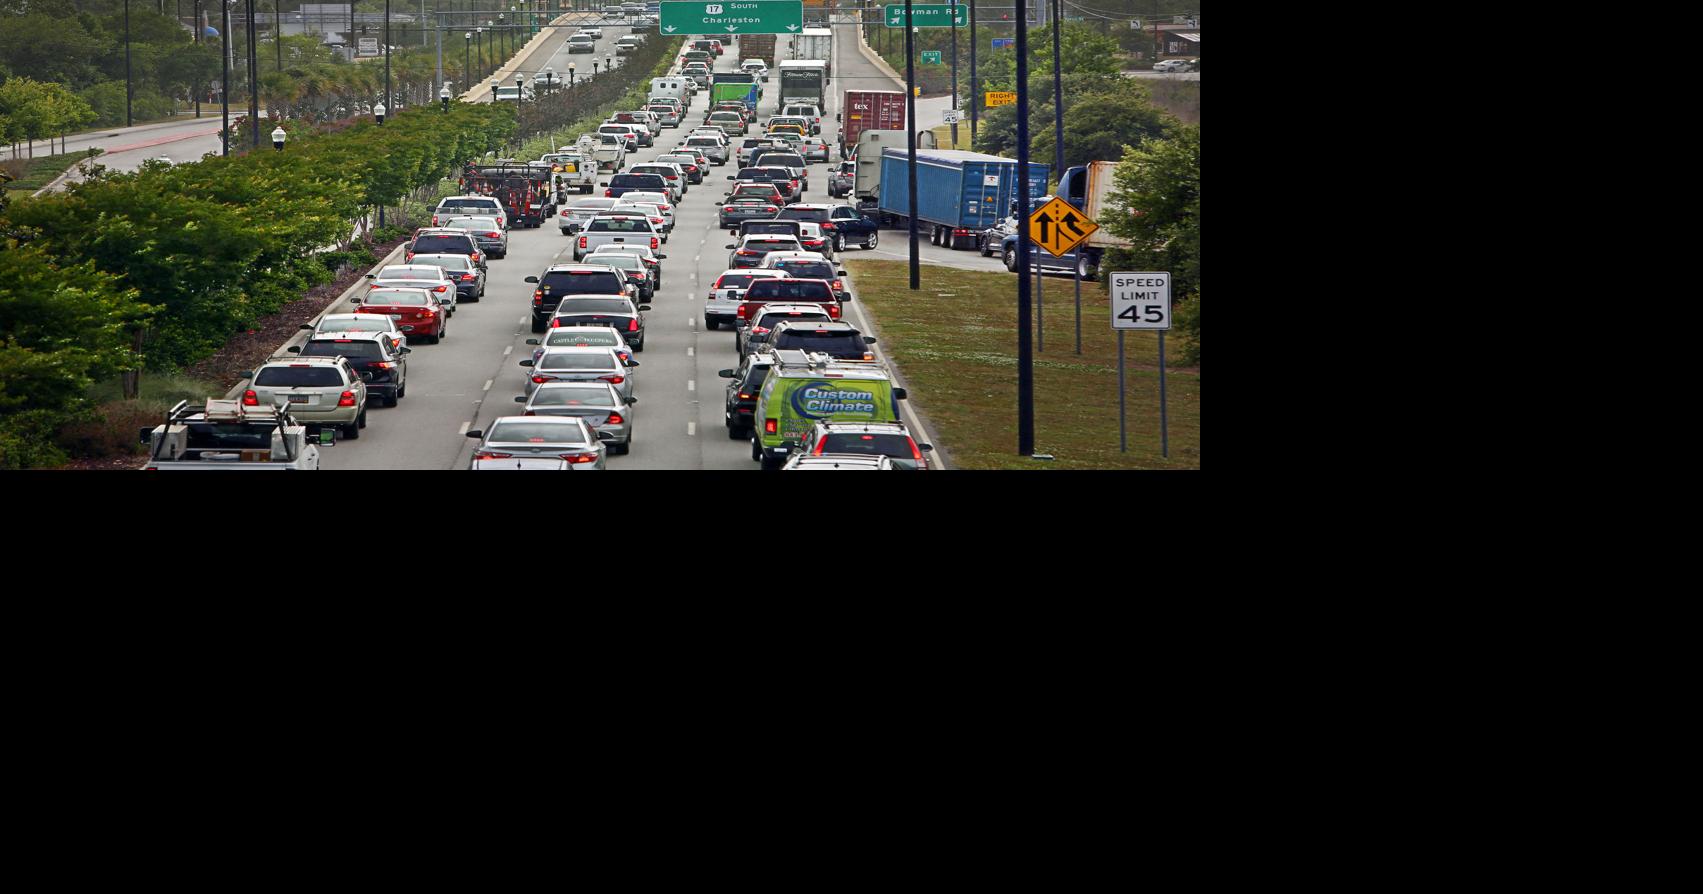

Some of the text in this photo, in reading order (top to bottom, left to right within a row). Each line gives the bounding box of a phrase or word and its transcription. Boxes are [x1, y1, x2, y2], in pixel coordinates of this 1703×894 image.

[709, 5, 719, 13] 17
[854, 102, 868, 110] tex
[1116, 278, 1165, 287] SPEED
[1121, 291, 1159, 300] LIMIT
[1117, 305, 1164, 323] 45
[804, 387, 872, 400] Custom
[806, 400, 874, 412] Climate
